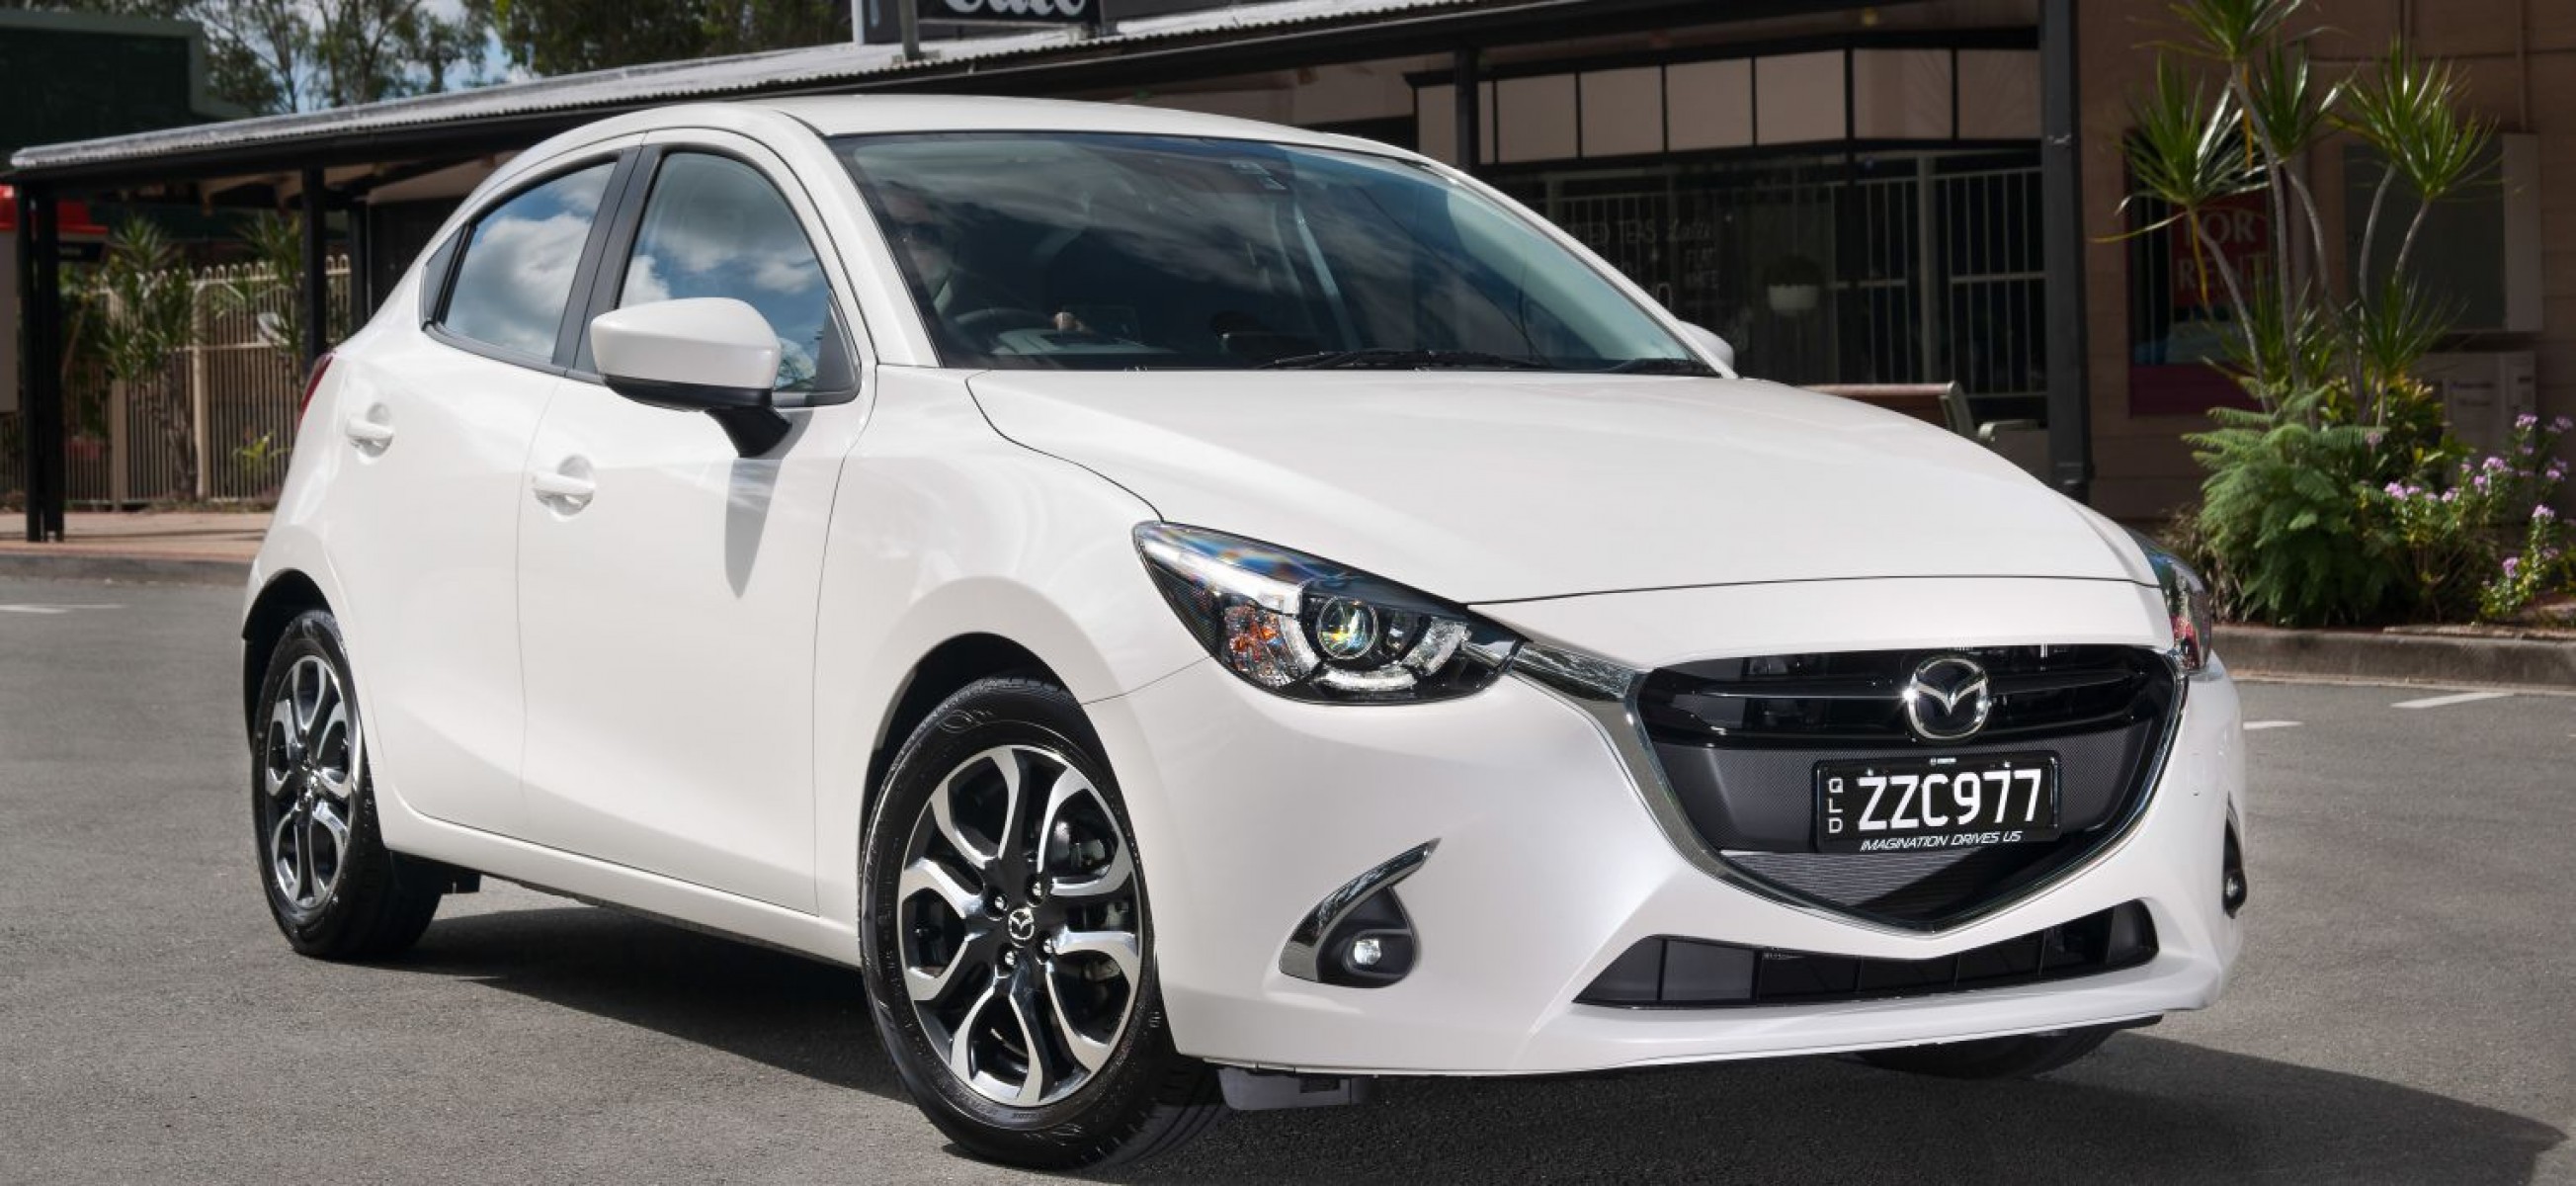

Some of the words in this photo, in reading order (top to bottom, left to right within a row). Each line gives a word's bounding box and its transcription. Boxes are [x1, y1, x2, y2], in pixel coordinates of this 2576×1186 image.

[1828, 778, 1844, 834] QLD
[1857, 768, 2041, 831] ZZC977
[1859, 834, 1950, 852] IMAGINATION
[1951, 830, 2000, 846] DRIVES
[2002, 830, 2024, 842] US
